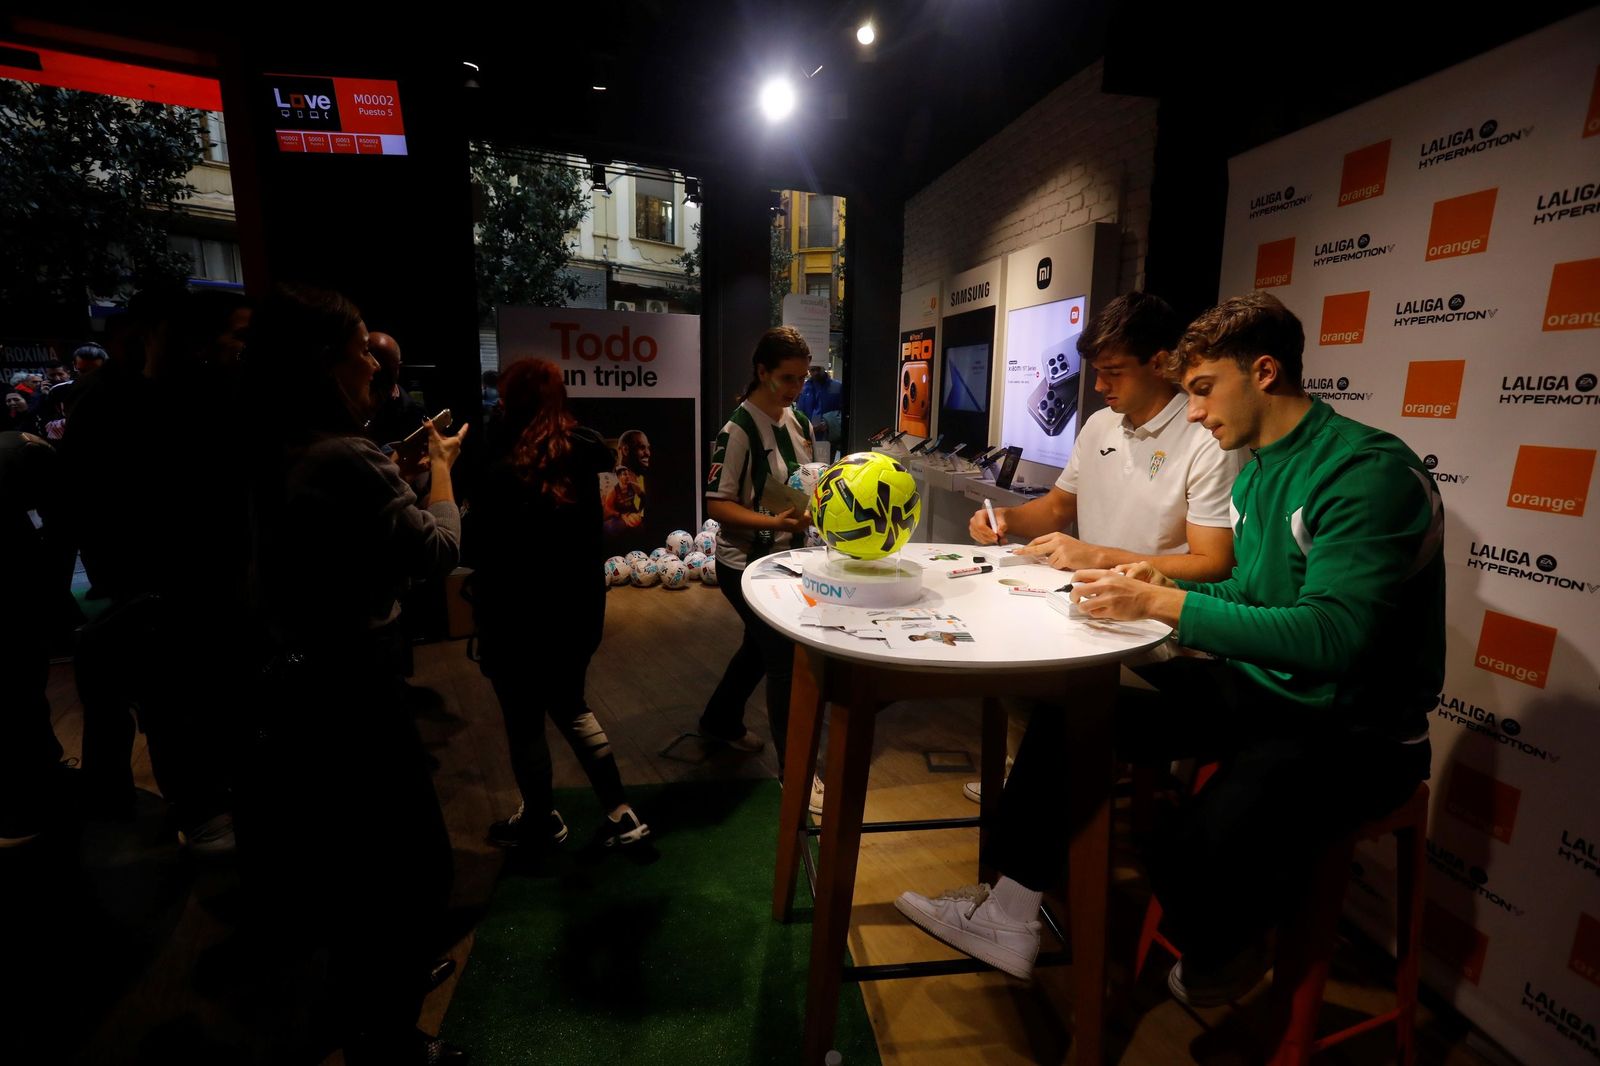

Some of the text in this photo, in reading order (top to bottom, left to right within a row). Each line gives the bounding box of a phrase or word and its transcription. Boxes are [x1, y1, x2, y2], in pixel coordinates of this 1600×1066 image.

[353, 94, 394, 106] M0002
[358, 107, 385, 116] Puesto
[1418, 131, 1522, 169] HYPERMOTION
[1420, 128, 1475, 157] LALIGA
[1250, 191, 1282, 210] LALIGA
[1340, 183, 1380, 203] orange
[1249, 198, 1307, 220] HYPERMOTION
[1533, 203, 1600, 225] HYPER
[1313, 246, 1387, 267] HYPERMOTION
[1314, 238, 1355, 257] LALIGA
[1428, 237, 1481, 257] orange
[1255, 272, 1288, 287] orange
[950, 281, 990, 307] SAMSUNG
[1396, 298, 1444, 315] LALIGA
[1394, 310, 1486, 327] HYPERMOTION
[1547, 311, 1600, 327] orang
[550, 322, 658, 362] Todo
[1321, 330, 1360, 344] orange
[902, 339, 932, 361] PRO
[594, 365, 658, 391] triple
[1302, 378, 1334, 389] LALIGA
[1502, 376, 1569, 391] LALIGA
[1404, 401, 1451, 416] orange
[1511, 492, 1576, 512] orange
[1470, 543, 1530, 567] LALIGA
[1467, 558, 1585, 592] HYPERMOTION
[803, 577, 842, 598] OTION
[1478, 653, 1539, 682] orange
[1440, 693, 1496, 727] LALIGA
[1438, 709, 1547, 760] HYPERMOTION
[1525, 982, 1596, 1042] LALIGA
